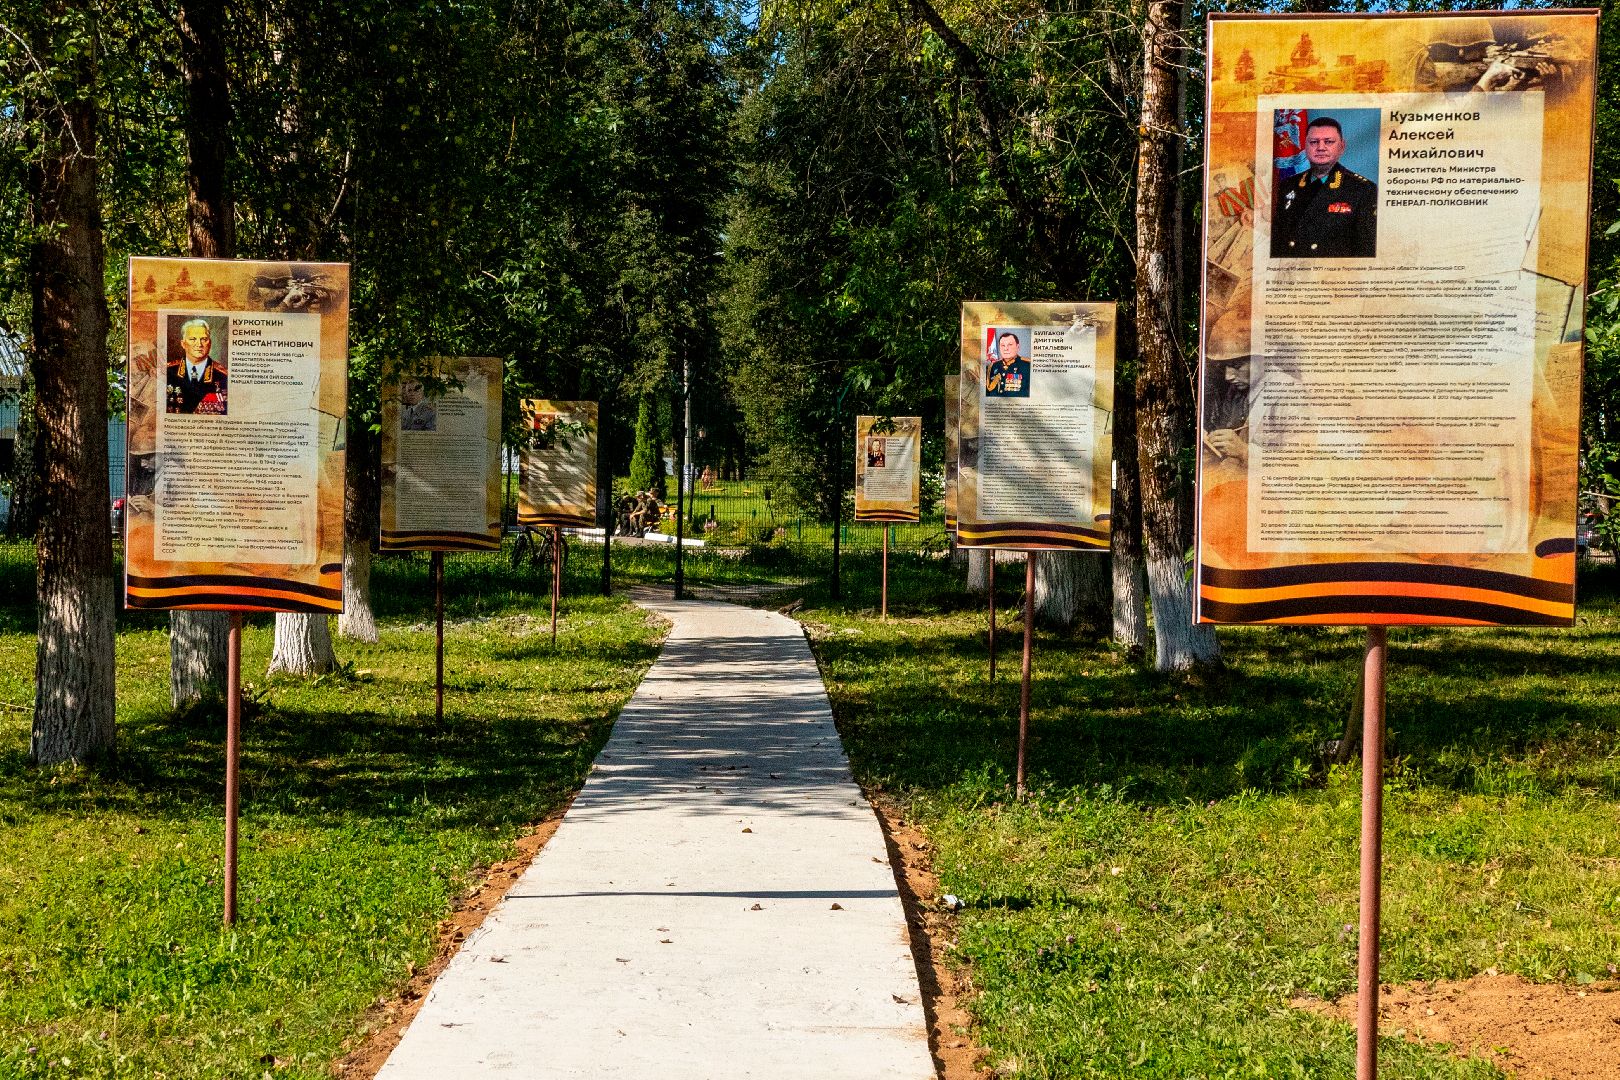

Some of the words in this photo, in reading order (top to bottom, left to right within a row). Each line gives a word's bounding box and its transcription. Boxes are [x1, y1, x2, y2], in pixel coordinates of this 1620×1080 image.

[1390, 111, 1480, 124] Кузьменков
[1388, 128, 1454, 140] Алексей
[1388, 147, 1484, 159] Михайлович
[1386, 177, 1429, 185] обороны
[1386, 189, 1452, 197] техническому
[232, 318, 284, 326] КУРКОТКИН
[232, 340, 314, 348] КОНСТАНТИНОВИЧ
